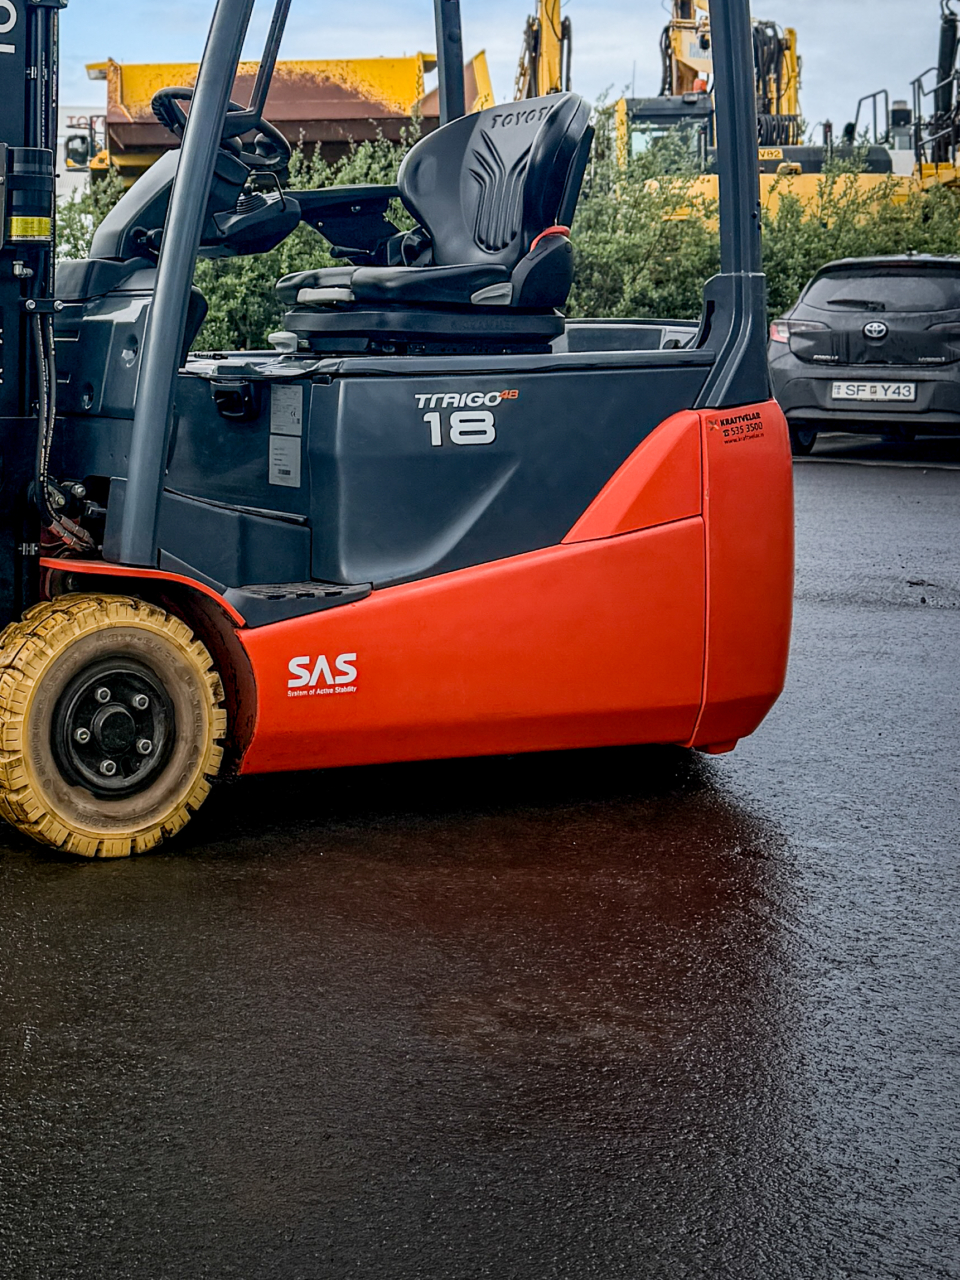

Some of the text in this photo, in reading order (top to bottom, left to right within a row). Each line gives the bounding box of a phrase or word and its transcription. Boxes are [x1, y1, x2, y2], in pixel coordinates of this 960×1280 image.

[845, 384, 912, 398] SF Y43
[423, 410, 496, 446] 18
[730, 421, 763, 436] 535 3500
[288, 653, 358, 688] SAS
[287, 685, 358, 698] System of Active Stability
